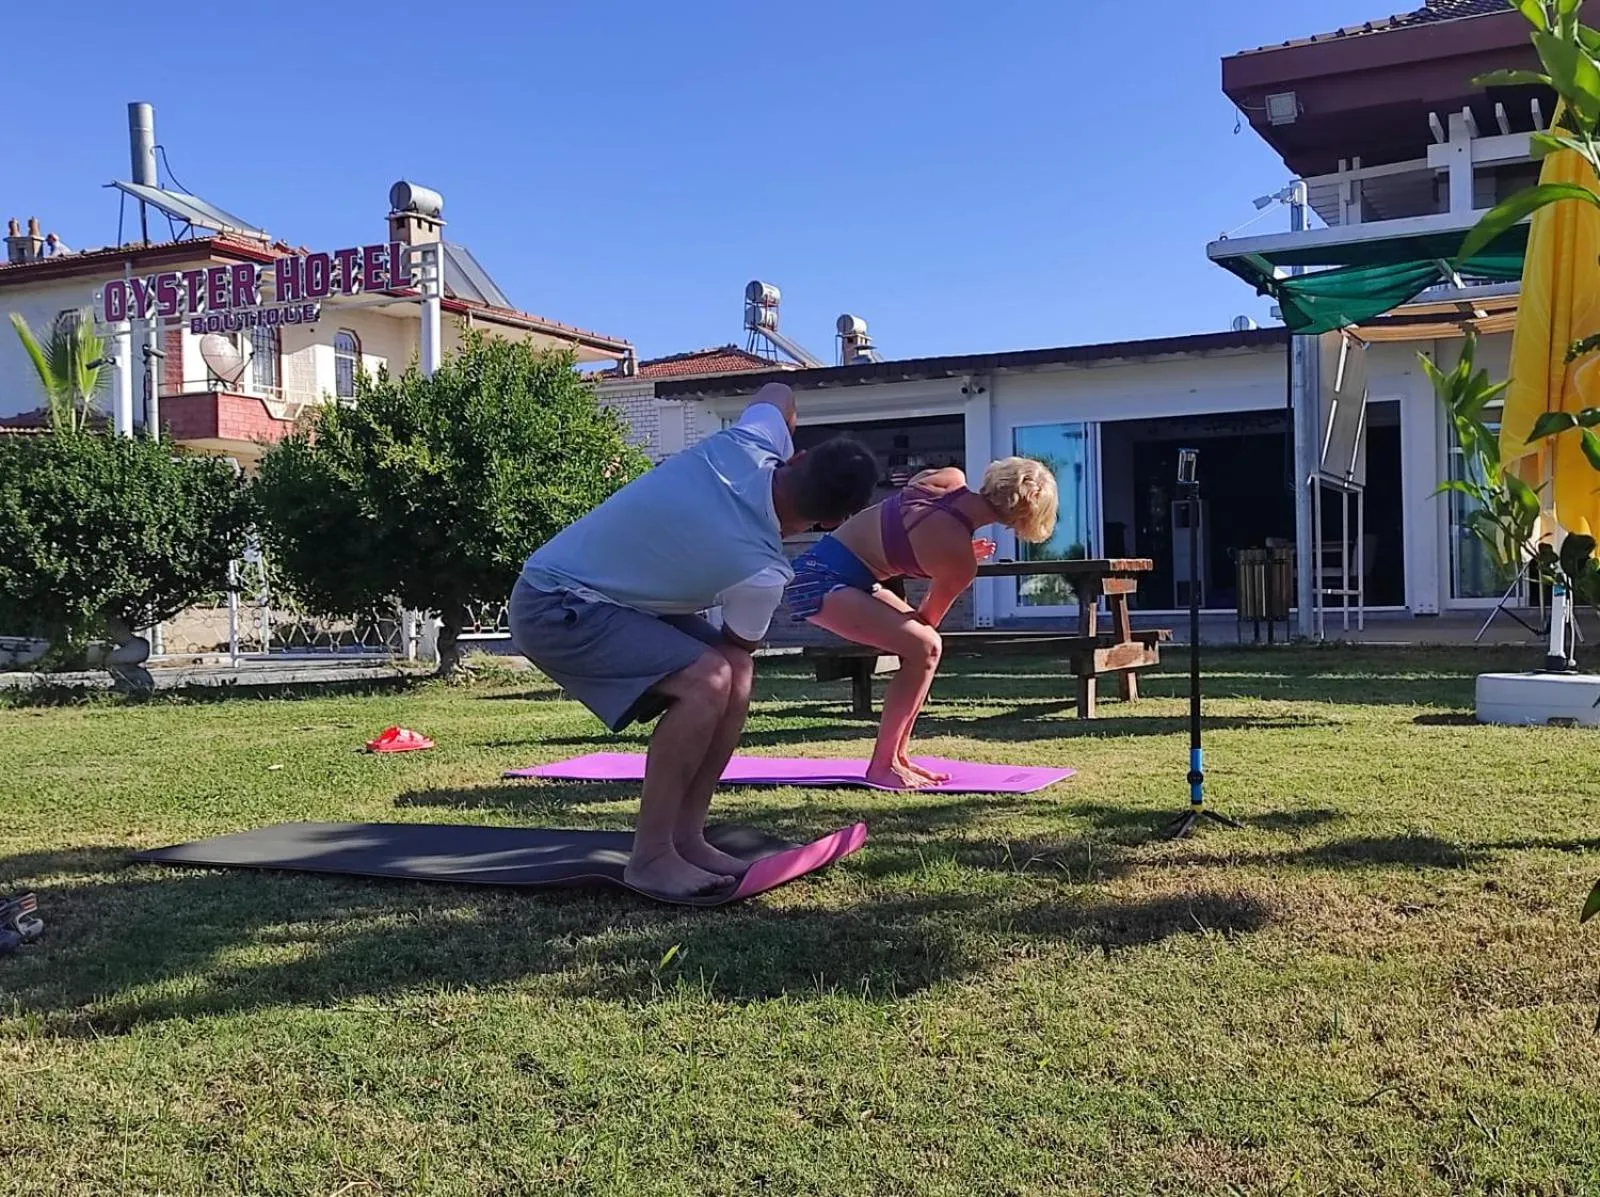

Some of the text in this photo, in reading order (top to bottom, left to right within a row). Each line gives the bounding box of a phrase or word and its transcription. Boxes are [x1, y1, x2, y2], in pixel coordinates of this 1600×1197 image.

[104, 242, 413, 323] OYSTER HOTEL
[190, 303, 319, 334] BOUTIQUE
